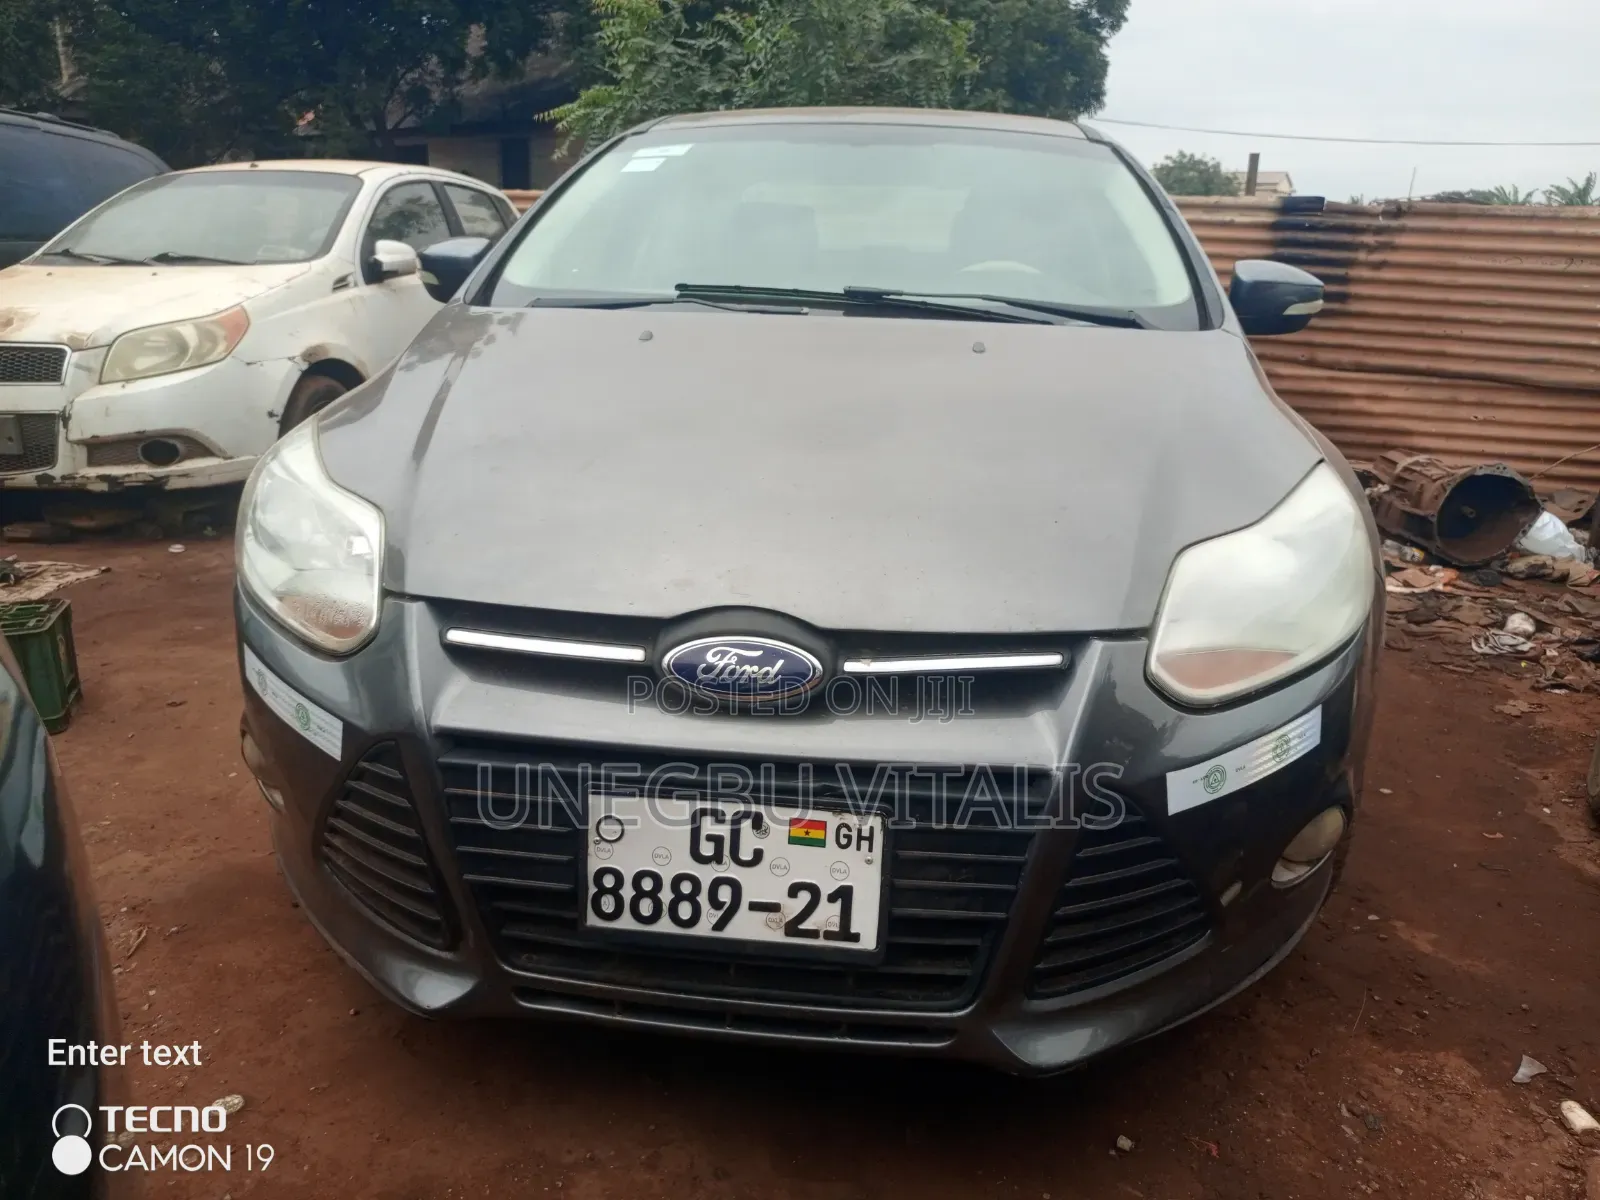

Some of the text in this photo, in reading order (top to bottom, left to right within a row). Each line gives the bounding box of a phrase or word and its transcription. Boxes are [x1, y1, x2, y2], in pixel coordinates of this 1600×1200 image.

[697, 646, 784, 685] Ford
[690, 807, 874, 868] GC GH
[591, 866, 861, 943] 8889-21
